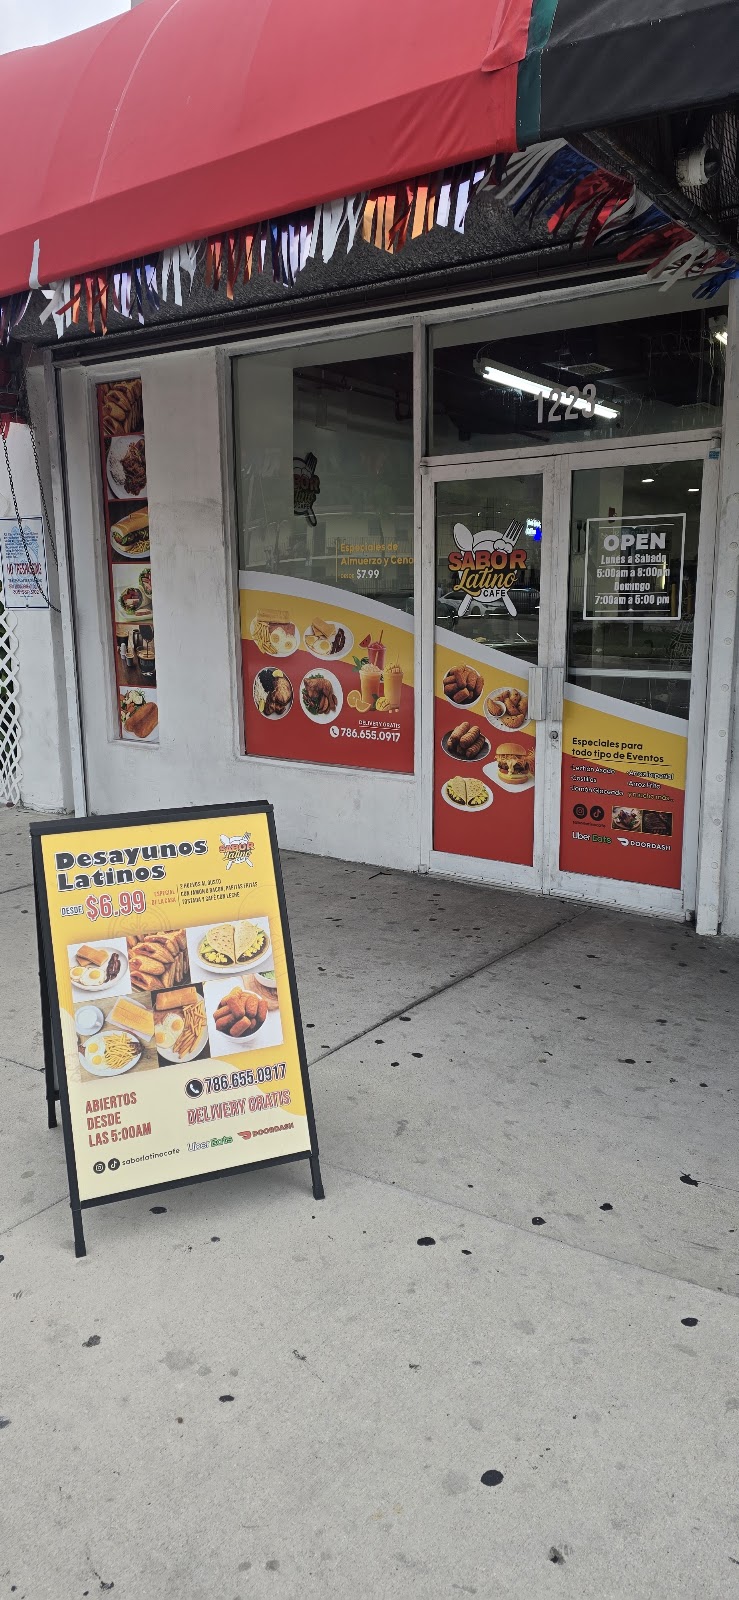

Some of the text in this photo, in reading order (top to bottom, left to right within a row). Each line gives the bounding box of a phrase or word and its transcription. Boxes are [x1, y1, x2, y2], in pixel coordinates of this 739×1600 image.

[533, 383, 597, 424] 1223
[340, 542, 399, 553] Especiales de
[603, 532, 666, 552] OPEN
[340, 556, 382, 566] Almuerzo
[383, 557, 390, 567] y
[448, 549, 527, 572] SABOR
[601, 554, 625, 565] Lunes
[356, 568, 380, 579] $7.99
[630, 569, 635, 577] a
[453, 567, 518, 597] Latino
[614, 581, 650, 592] Domingo
[483, 589, 506, 597] CAFE
[594, 595, 626, 605] 7:00am
[627, 596, 633, 605] a
[656, 595, 670, 606] pm
[341, 727, 401, 742] 786.655.0917
[572, 737, 643, 750] Especiales para
[571, 748, 664, 763] todo tipo de Eventos
[571, 831, 612, 845] Uber Eats
[630, 840, 671, 851] DOORDASH
[55, 839, 208, 870] Desayunos
[218, 841, 255, 853] SABOR
[56, 864, 167, 891] Latinos
[61, 890, 146, 921] DESDE $6.99
[204, 1063, 287, 1094] 786.655.0917
[85, 1091, 138, 1115] ABIERTOS
[187, 1089, 292, 1126] DELIVERY GRATIS
[87, 1111, 122, 1131] DESDE
[251, 1121, 295, 1138] DOORDASH
[88, 1121, 152, 1148] LAS 5:00AM
[187, 1135, 234, 1152] Uber Eats
[121, 1147, 181, 1166] saborlatinocafe
